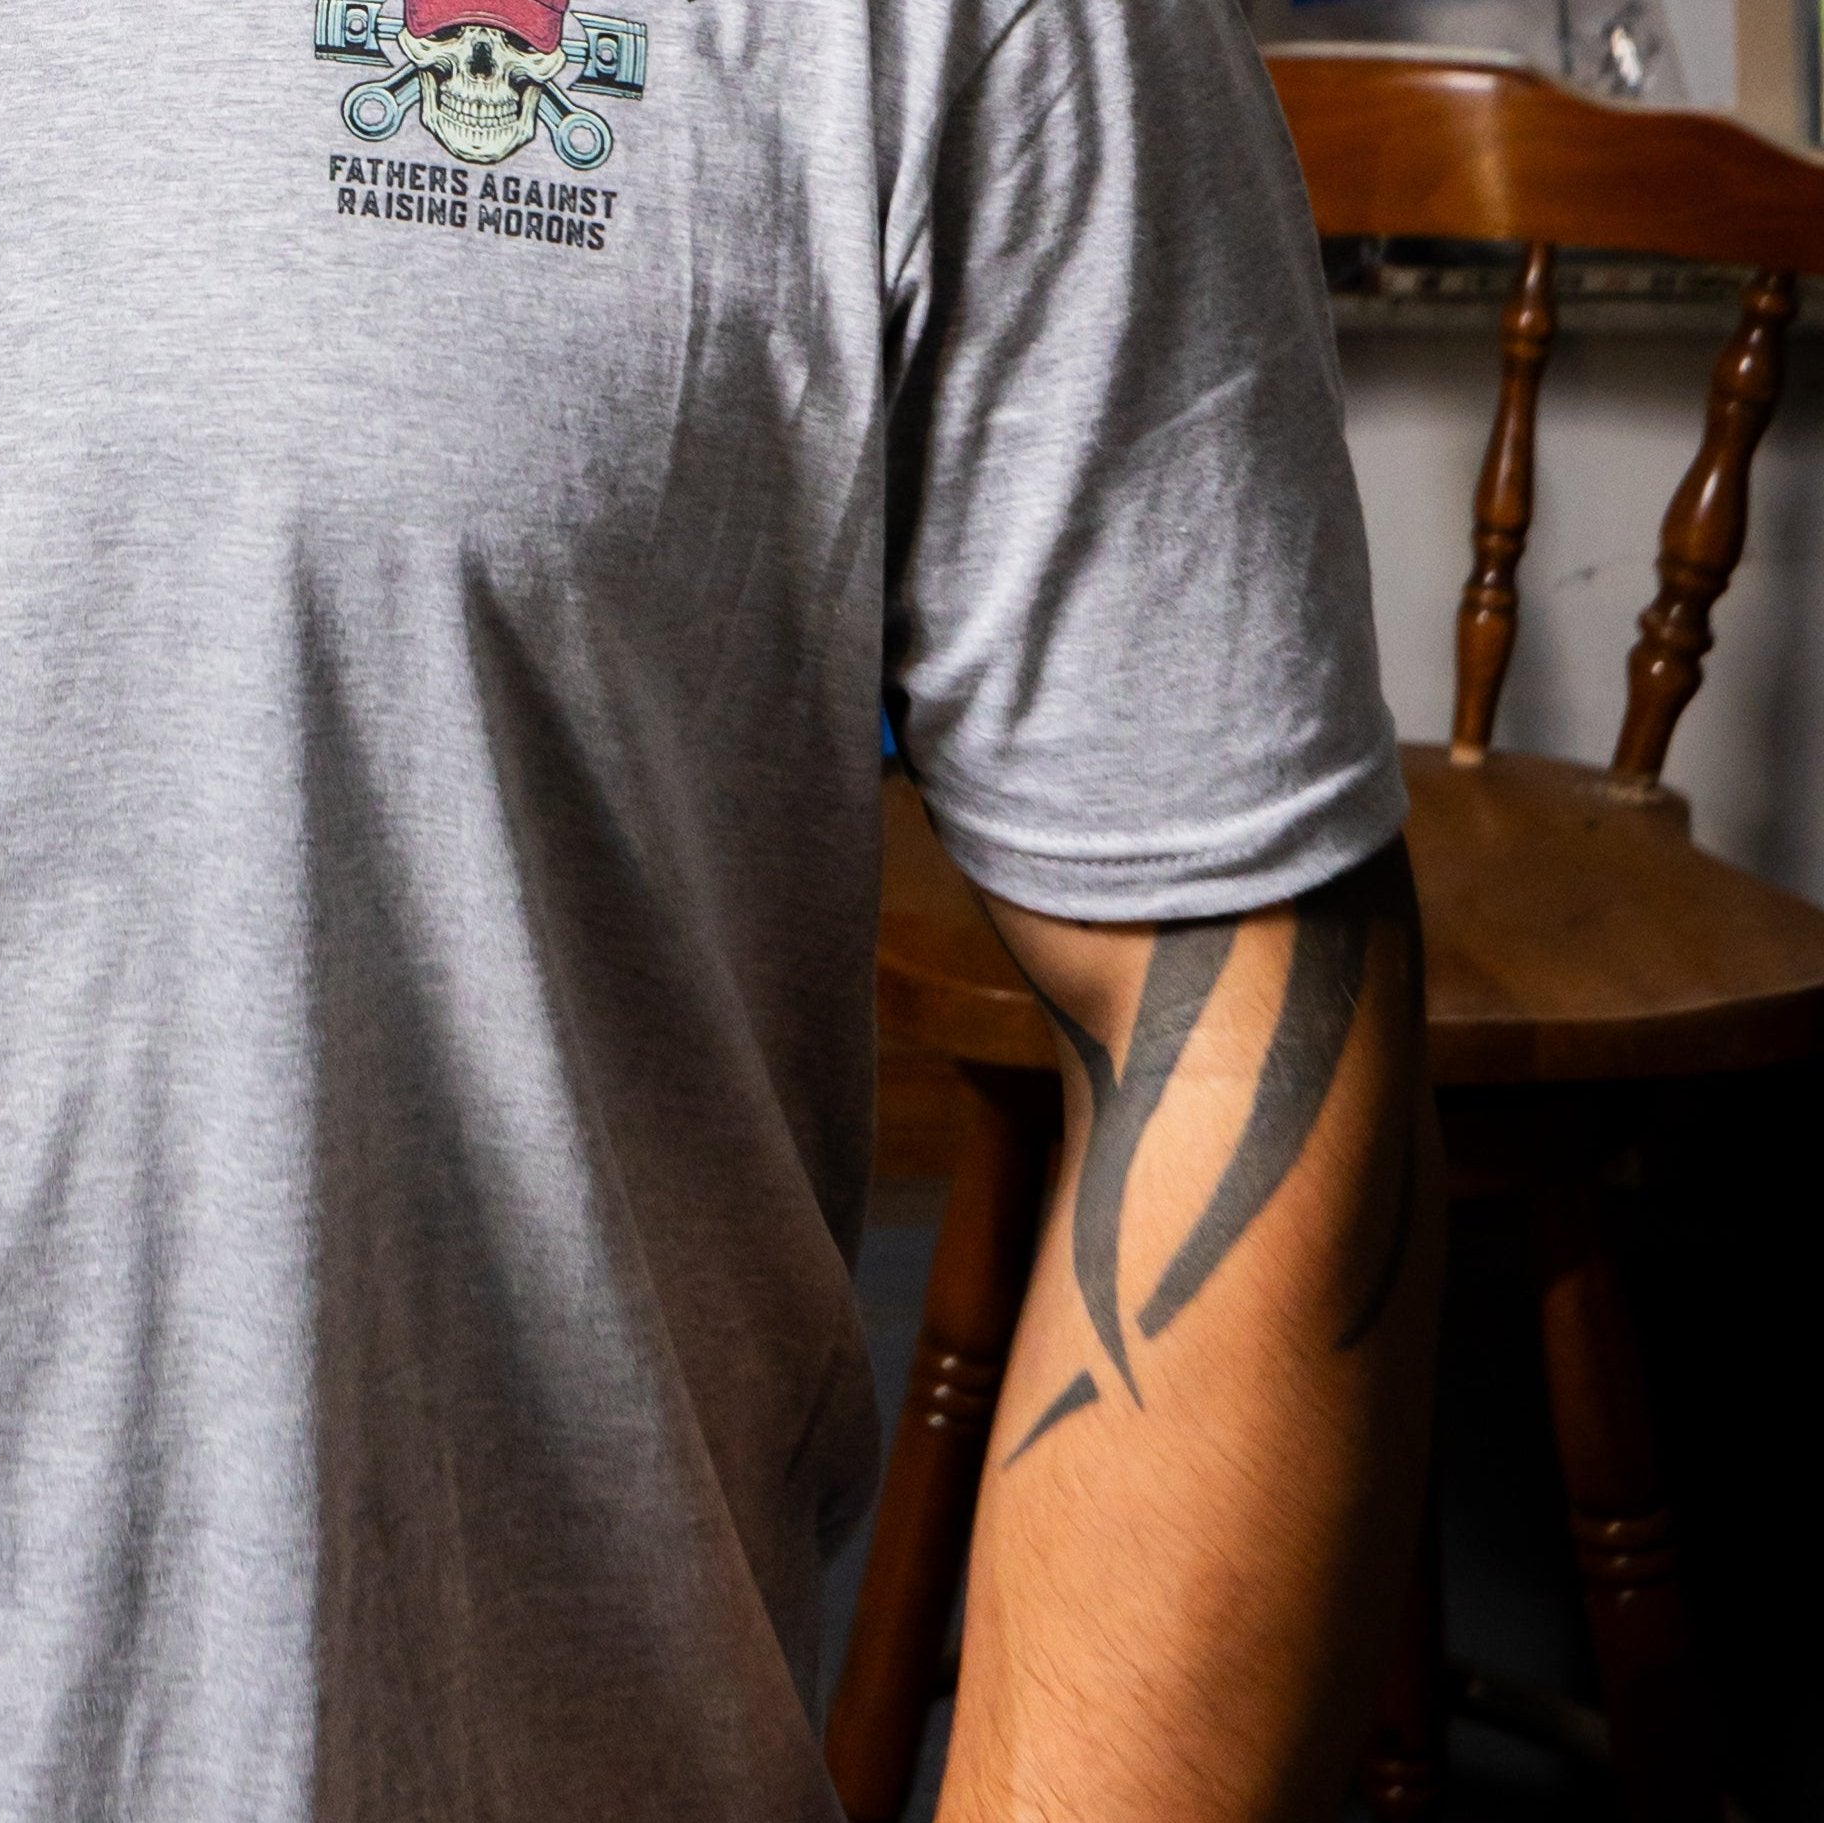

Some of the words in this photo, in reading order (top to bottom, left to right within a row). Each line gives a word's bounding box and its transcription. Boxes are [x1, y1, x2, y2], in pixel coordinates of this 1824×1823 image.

[329, 154, 469, 197] FATHERS
[479, 172, 617, 219] AGAINST
[337, 187, 468, 228] RAISING
[478, 204, 607, 251] MORONS
